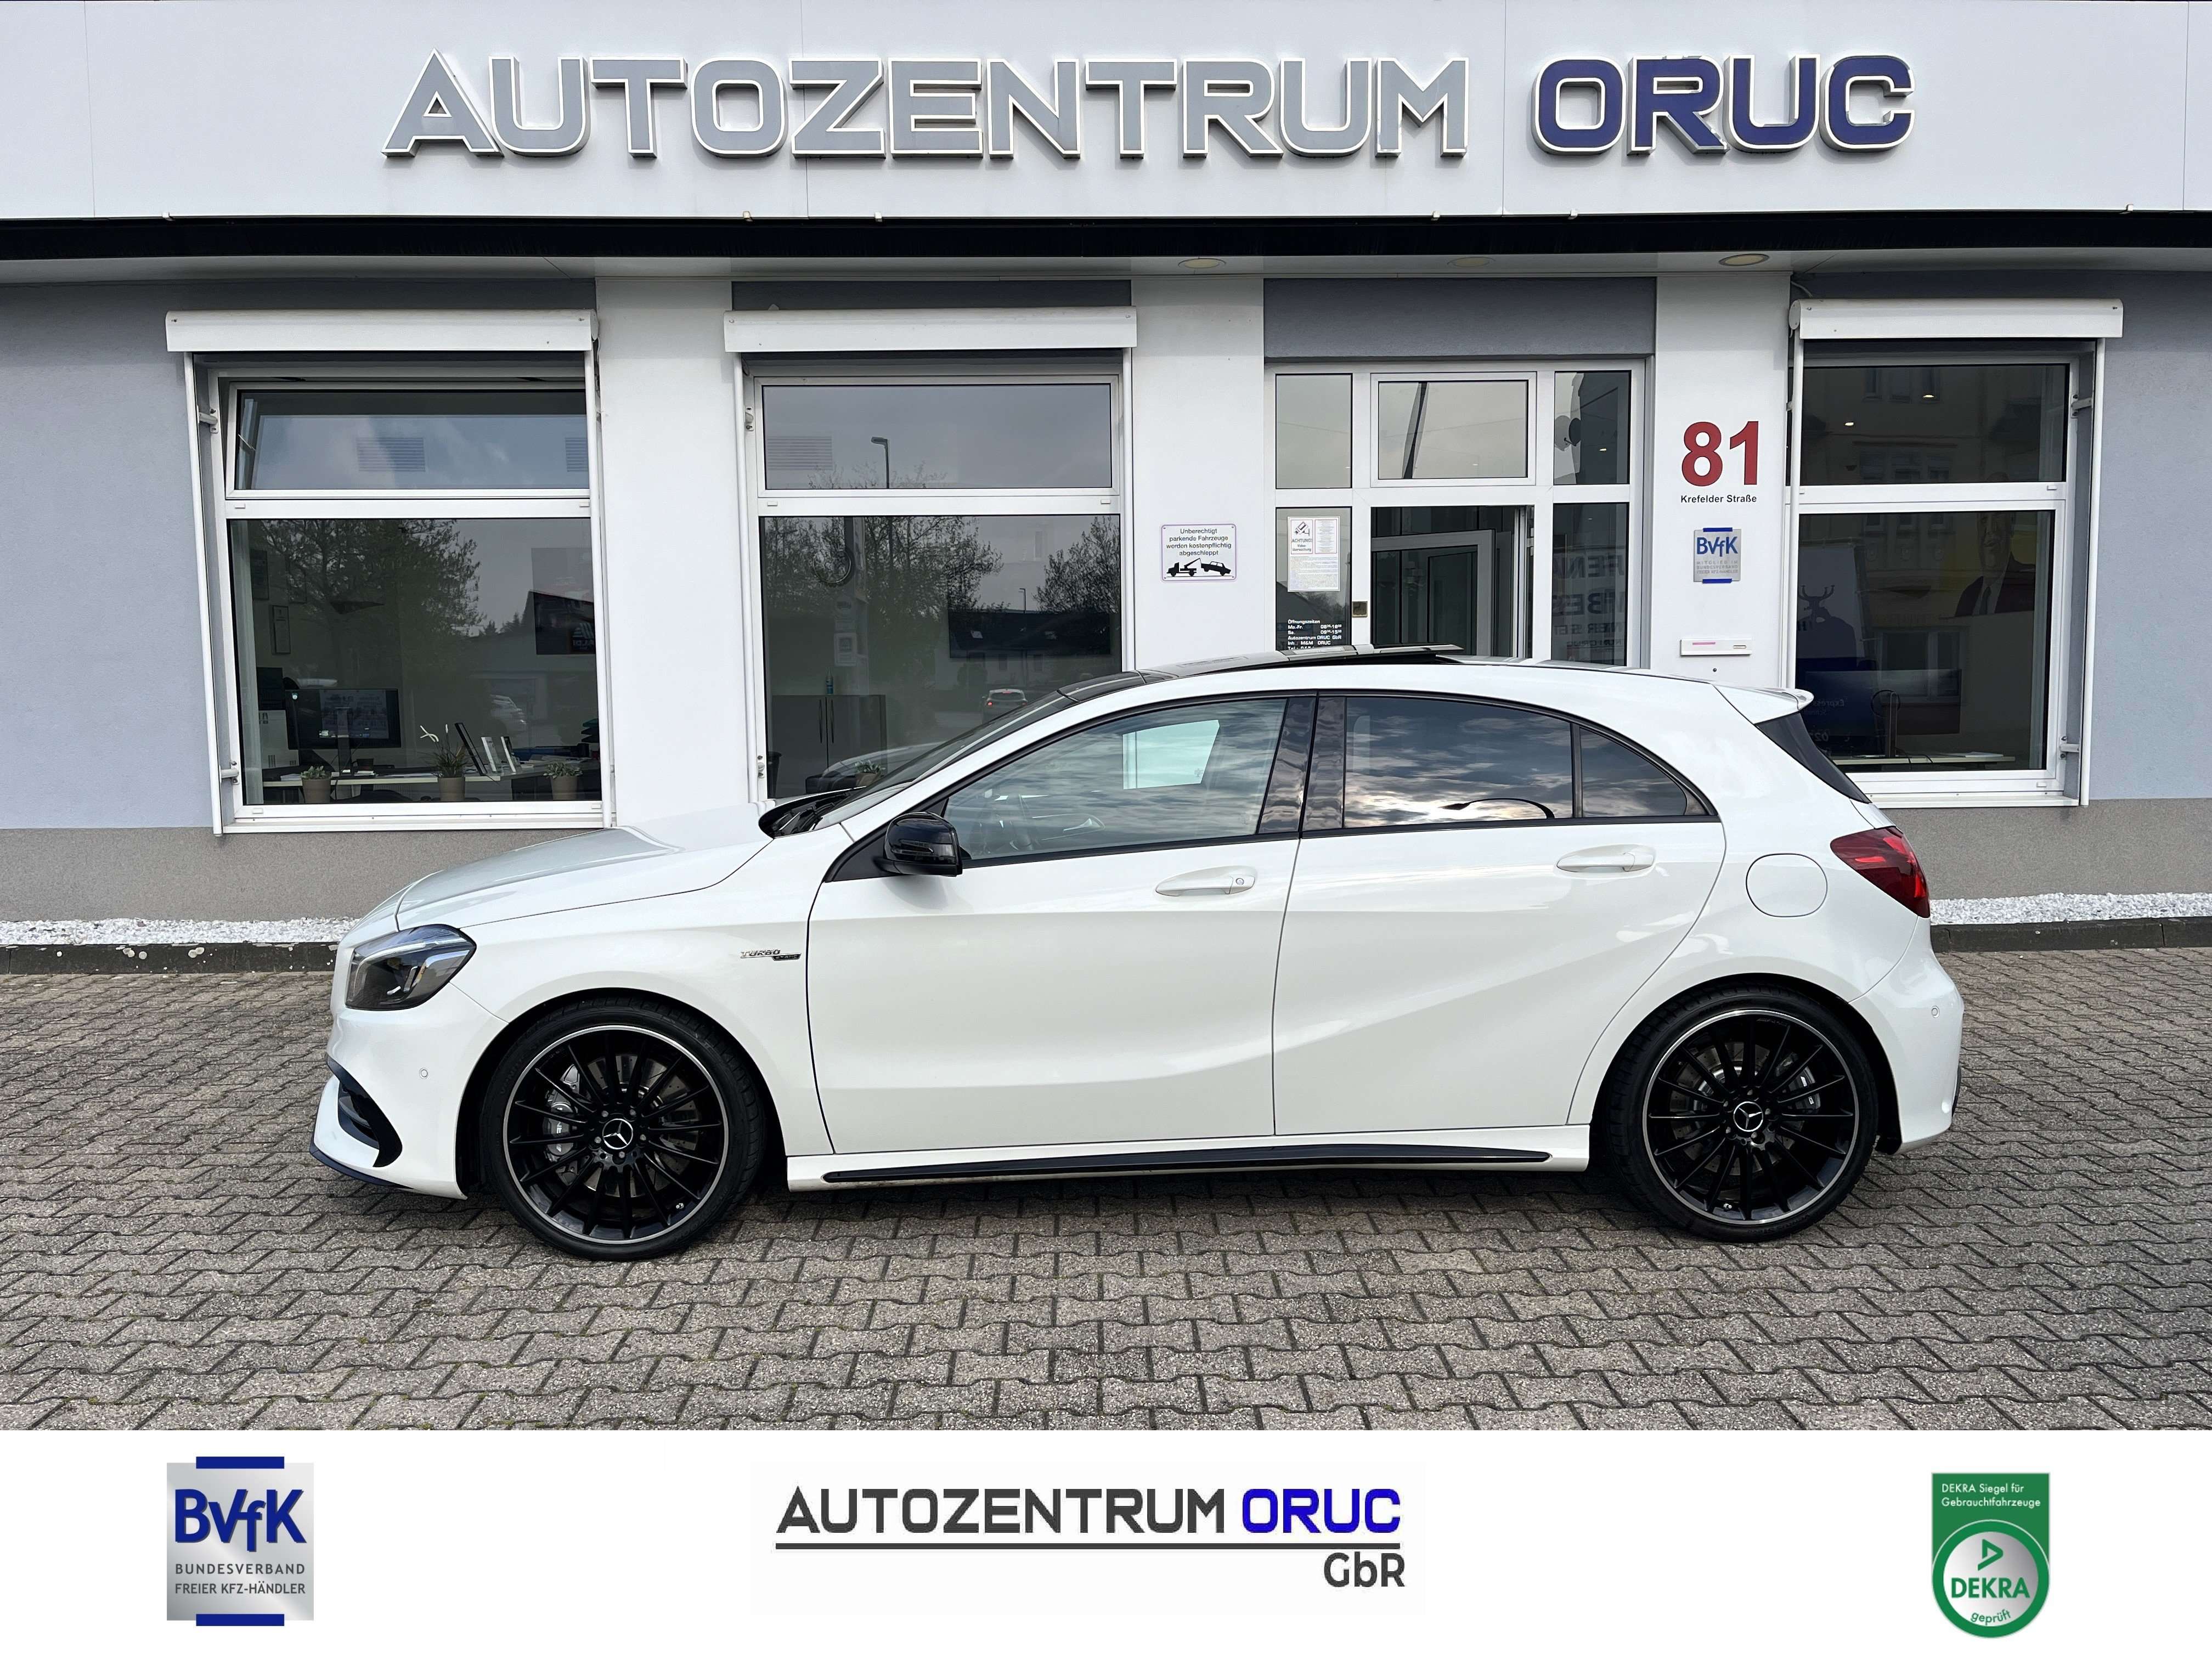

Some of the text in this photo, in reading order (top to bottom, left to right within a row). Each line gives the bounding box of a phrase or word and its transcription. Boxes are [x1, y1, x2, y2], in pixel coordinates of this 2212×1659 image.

[381, 48, 1915, 159] AUTOZENTRUM ORUC
[1682, 421, 1759, 486] 81
[1680, 494, 1757, 503] Krefelder Straße
[741, 949, 781, 957] TURBO
